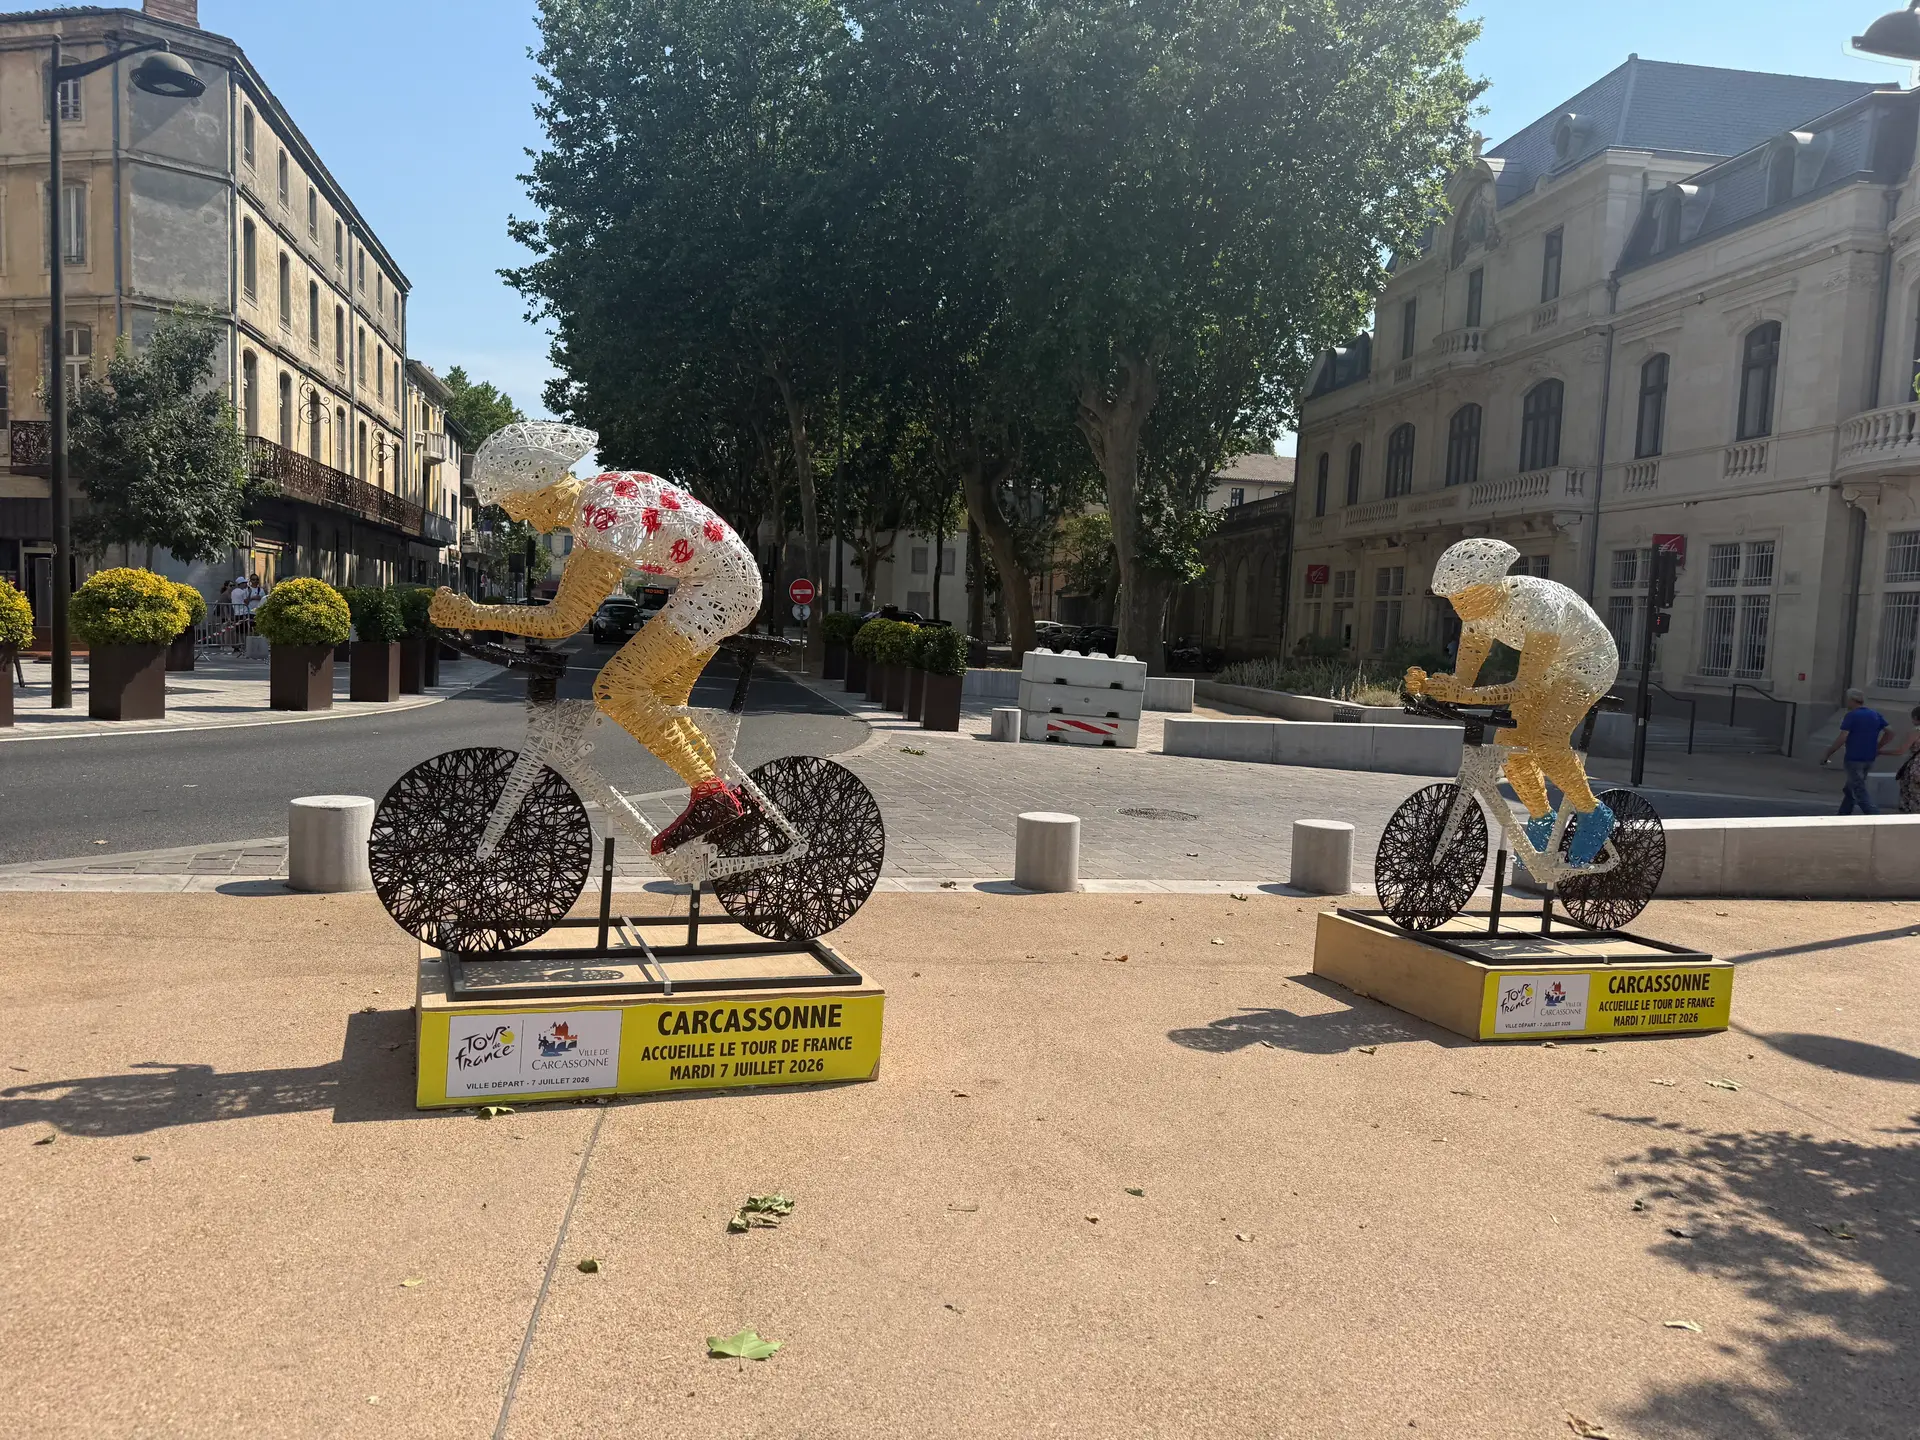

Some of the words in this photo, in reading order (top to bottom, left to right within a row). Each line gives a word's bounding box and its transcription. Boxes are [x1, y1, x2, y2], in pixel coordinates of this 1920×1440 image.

[1608, 973, 1710, 994] CARCASSONNE
[1598, 1000, 1638, 1012] ACCUEILLE
[1641, 1000, 1650, 1010] LE
[1653, 998, 1672, 1010] TOUR
[1675, 998, 1684, 1008] DE
[1687, 997, 1715, 1008] FRANCE
[658, 1004, 842, 1036] CARCASSONNE
[1614, 1016, 1638, 1026] MARDI
[1641, 1015, 1646, 1025] 7
[1648, 1014, 1677, 1025] JUILLET
[1679, 1013, 1698, 1023] 2026
[641, 1043, 715, 1061] ACCUEILLE
[720, 1042, 736, 1056] LE
[741, 1040, 776, 1056] TOUR
[782, 1038, 799, 1053] DE
[803, 1036, 853, 1052] FRANCE
[532, 1058, 609, 1070] CARCASSONNE
[670, 1064, 715, 1080] MARDI
[720, 1063, 729, 1077] 7
[734, 1060, 784, 1077] JUILLET
[789, 1058, 824, 1073] 2026
[492, 1080, 524, 1088] DÉPART
[538, 1078, 570, 1086] JUILLET
